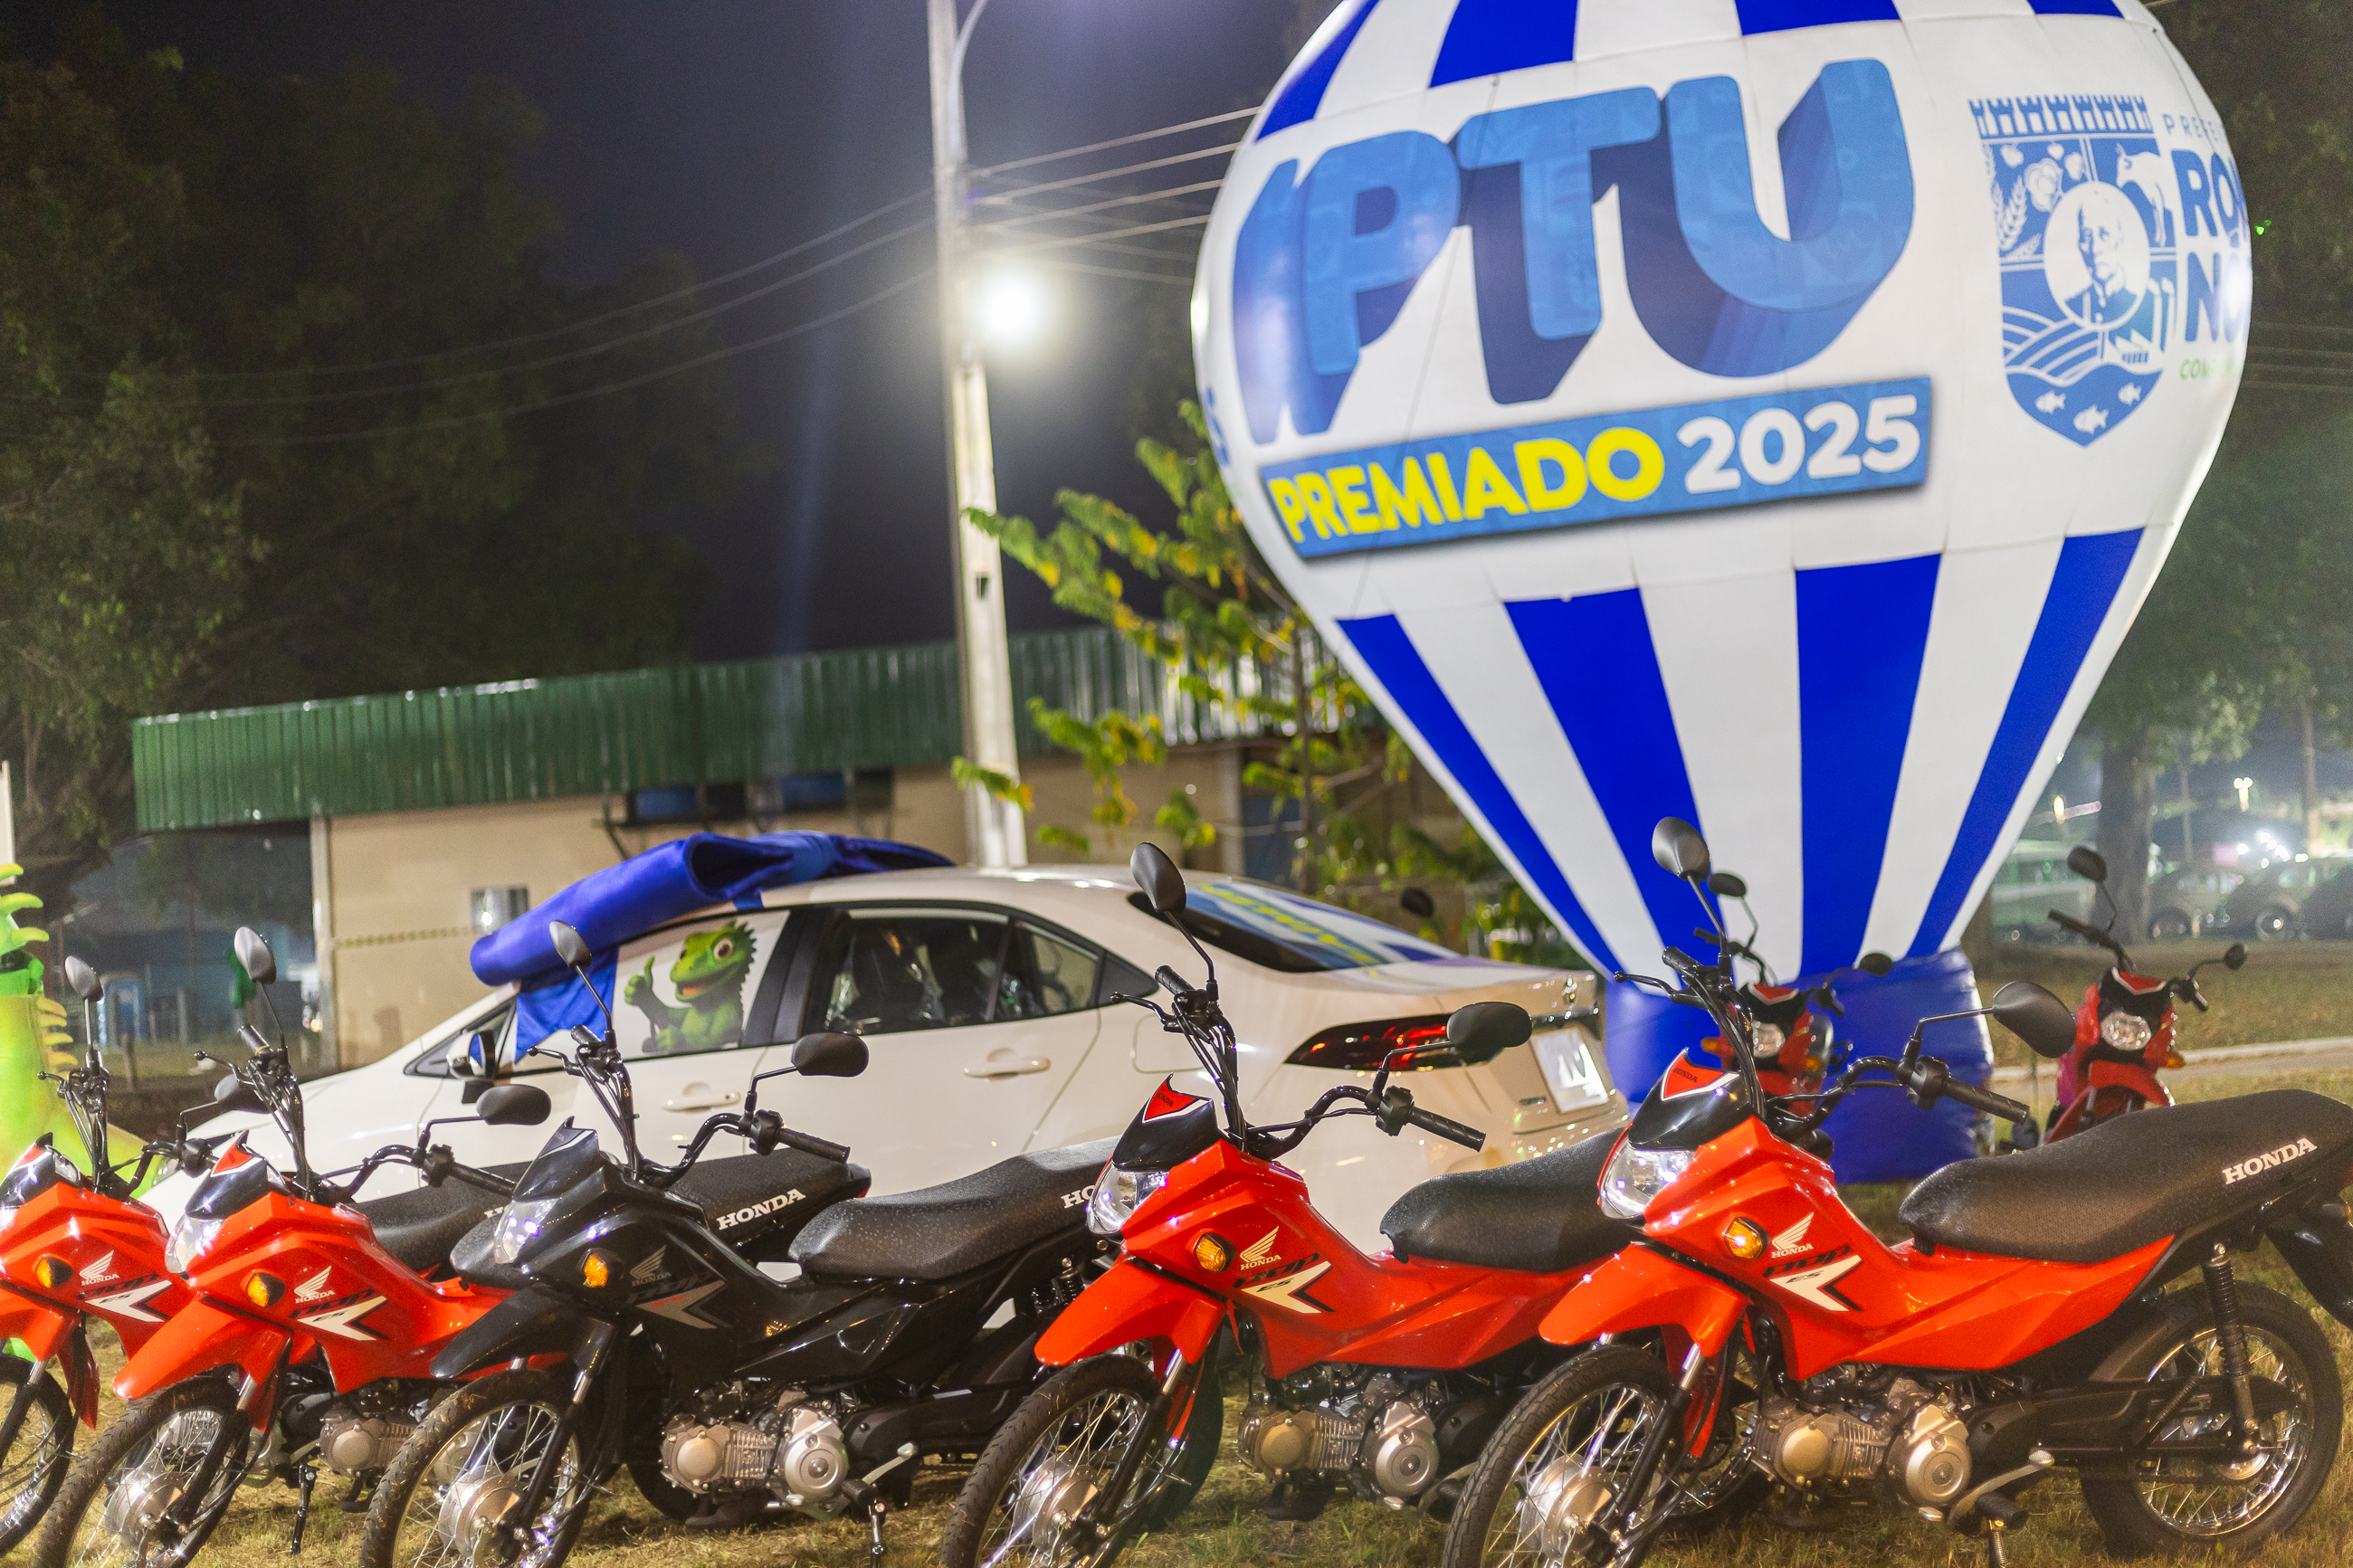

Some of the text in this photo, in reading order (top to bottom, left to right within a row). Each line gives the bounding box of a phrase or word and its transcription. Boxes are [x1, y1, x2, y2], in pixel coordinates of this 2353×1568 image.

[1233, 58, 1914, 445] IPTU
[1269, 426, 1665, 542] PREMIADO
[1676, 394, 1920, 494] 2025
[1673, 1068, 1698, 1083] HONDA
[1156, 1091, 1174, 1107] HONDA
[2222, 1137, 2318, 1185] HONDA
[716, 1188, 806, 1231] HONDA
[1771, 1243, 1815, 1259] HONDA
[1240, 1254, 1281, 1270] HONDA
[81, 1273, 119, 1286] HONDA
[632, 1271, 672, 1287] HONDA
[295, 1289, 336, 1304] HONDA
